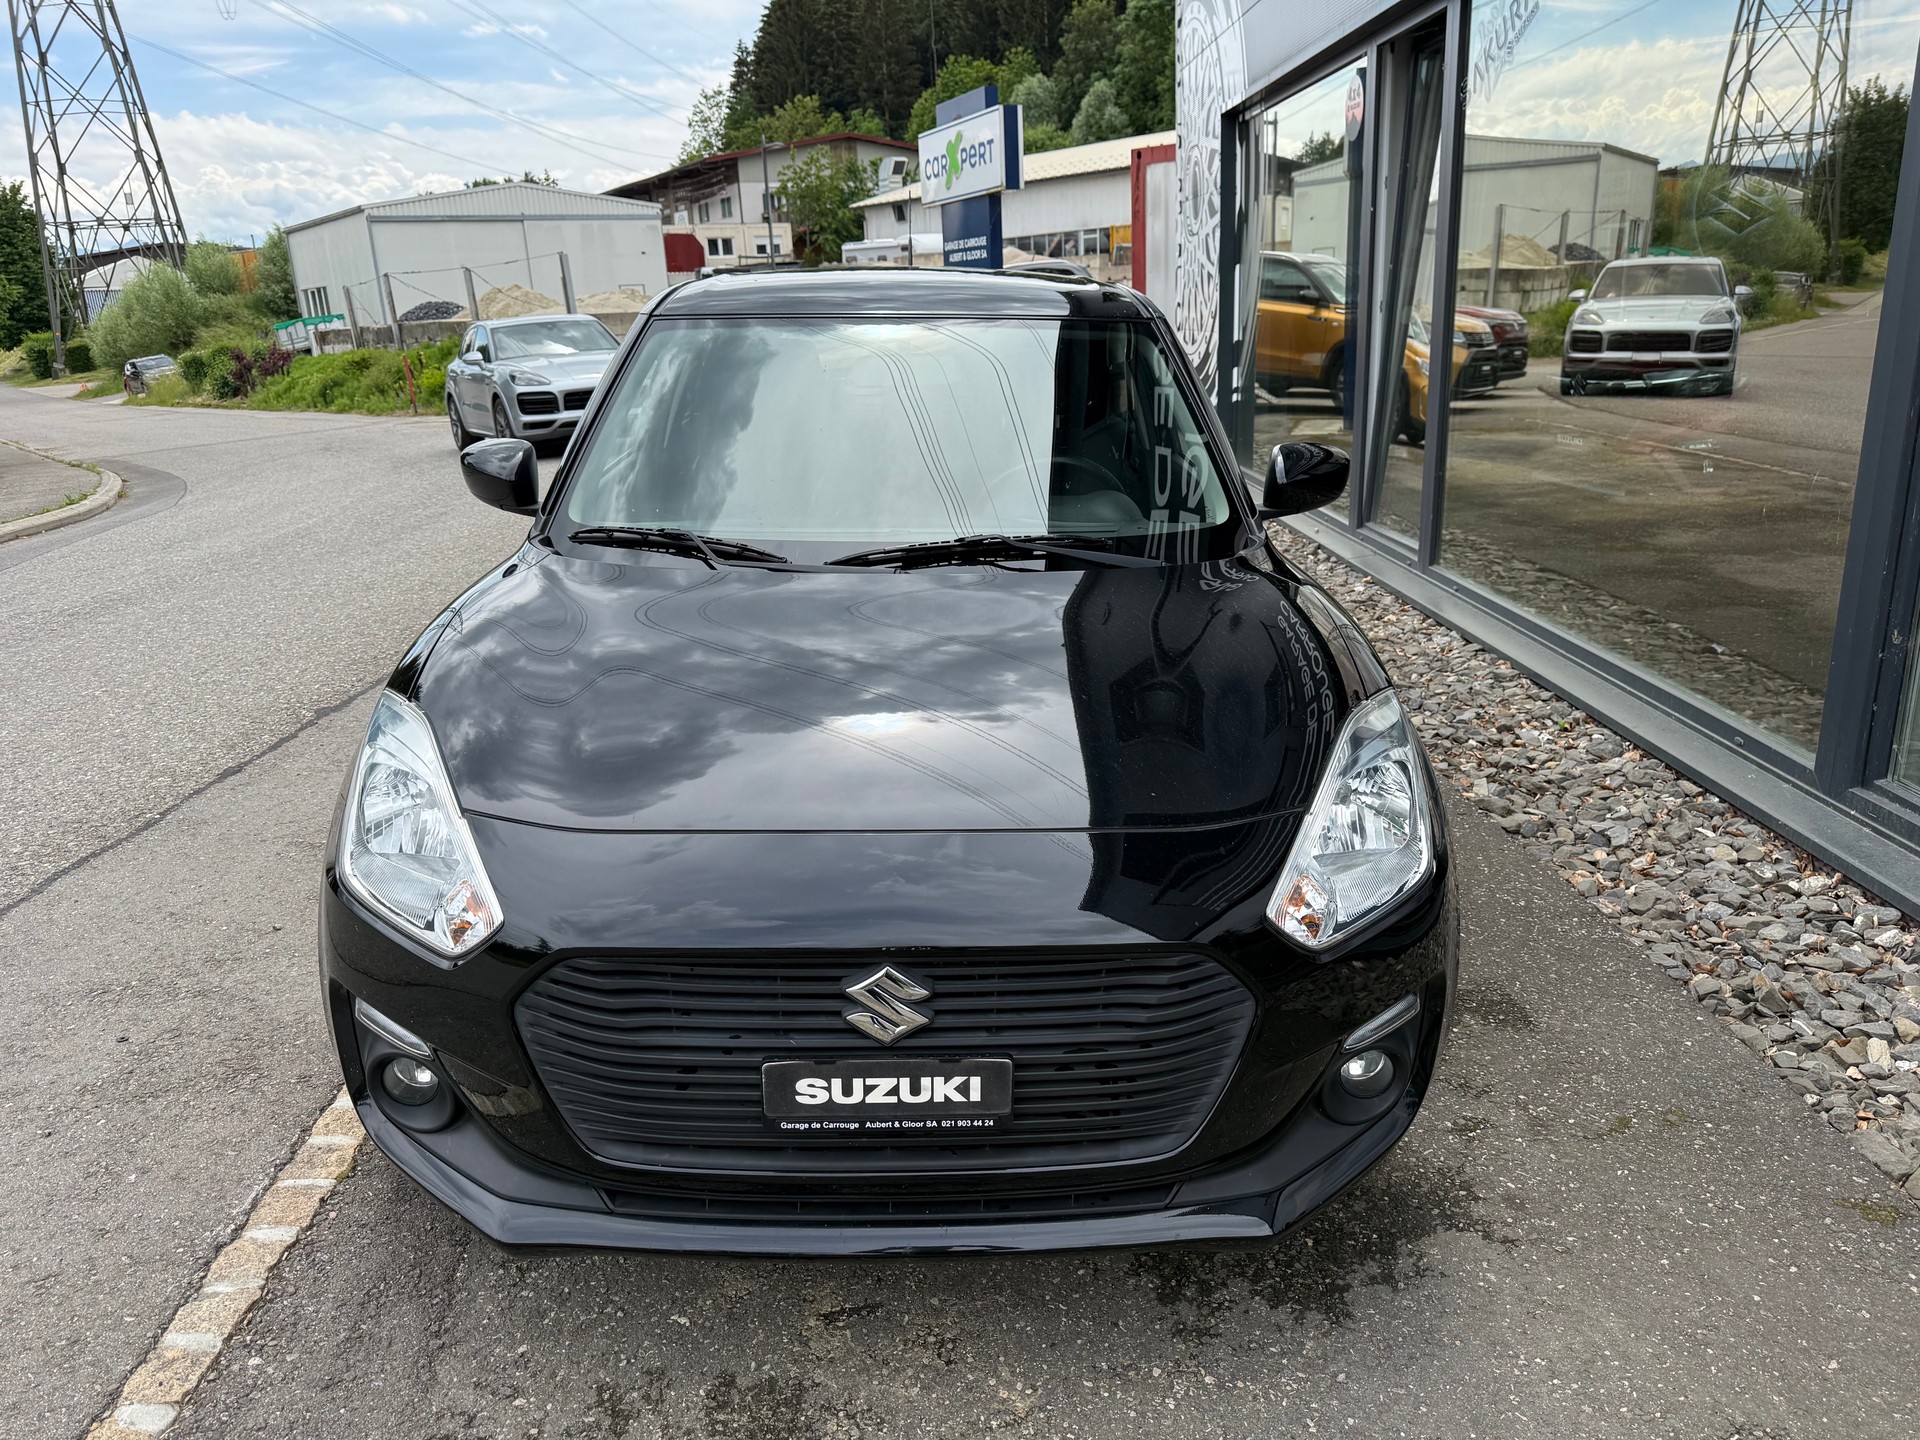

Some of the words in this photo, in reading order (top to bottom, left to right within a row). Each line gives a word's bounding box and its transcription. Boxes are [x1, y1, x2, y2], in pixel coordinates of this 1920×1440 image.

[794, 1076, 982, 1105] SUZUKI
[780, 1121, 809, 1130] Garage
[811, 1121, 821, 1129] de
[823, 1121, 859, 1130] Carrouge
[865, 1121, 892, 1129] Aubert
[902, 1120, 924, 1128] Gloor
[926, 1120, 938, 1128] SA
[957, 1119, 971, 1127] 903
[972, 1119, 983, 1127] 44
[984, 1119, 994, 1127] 24
